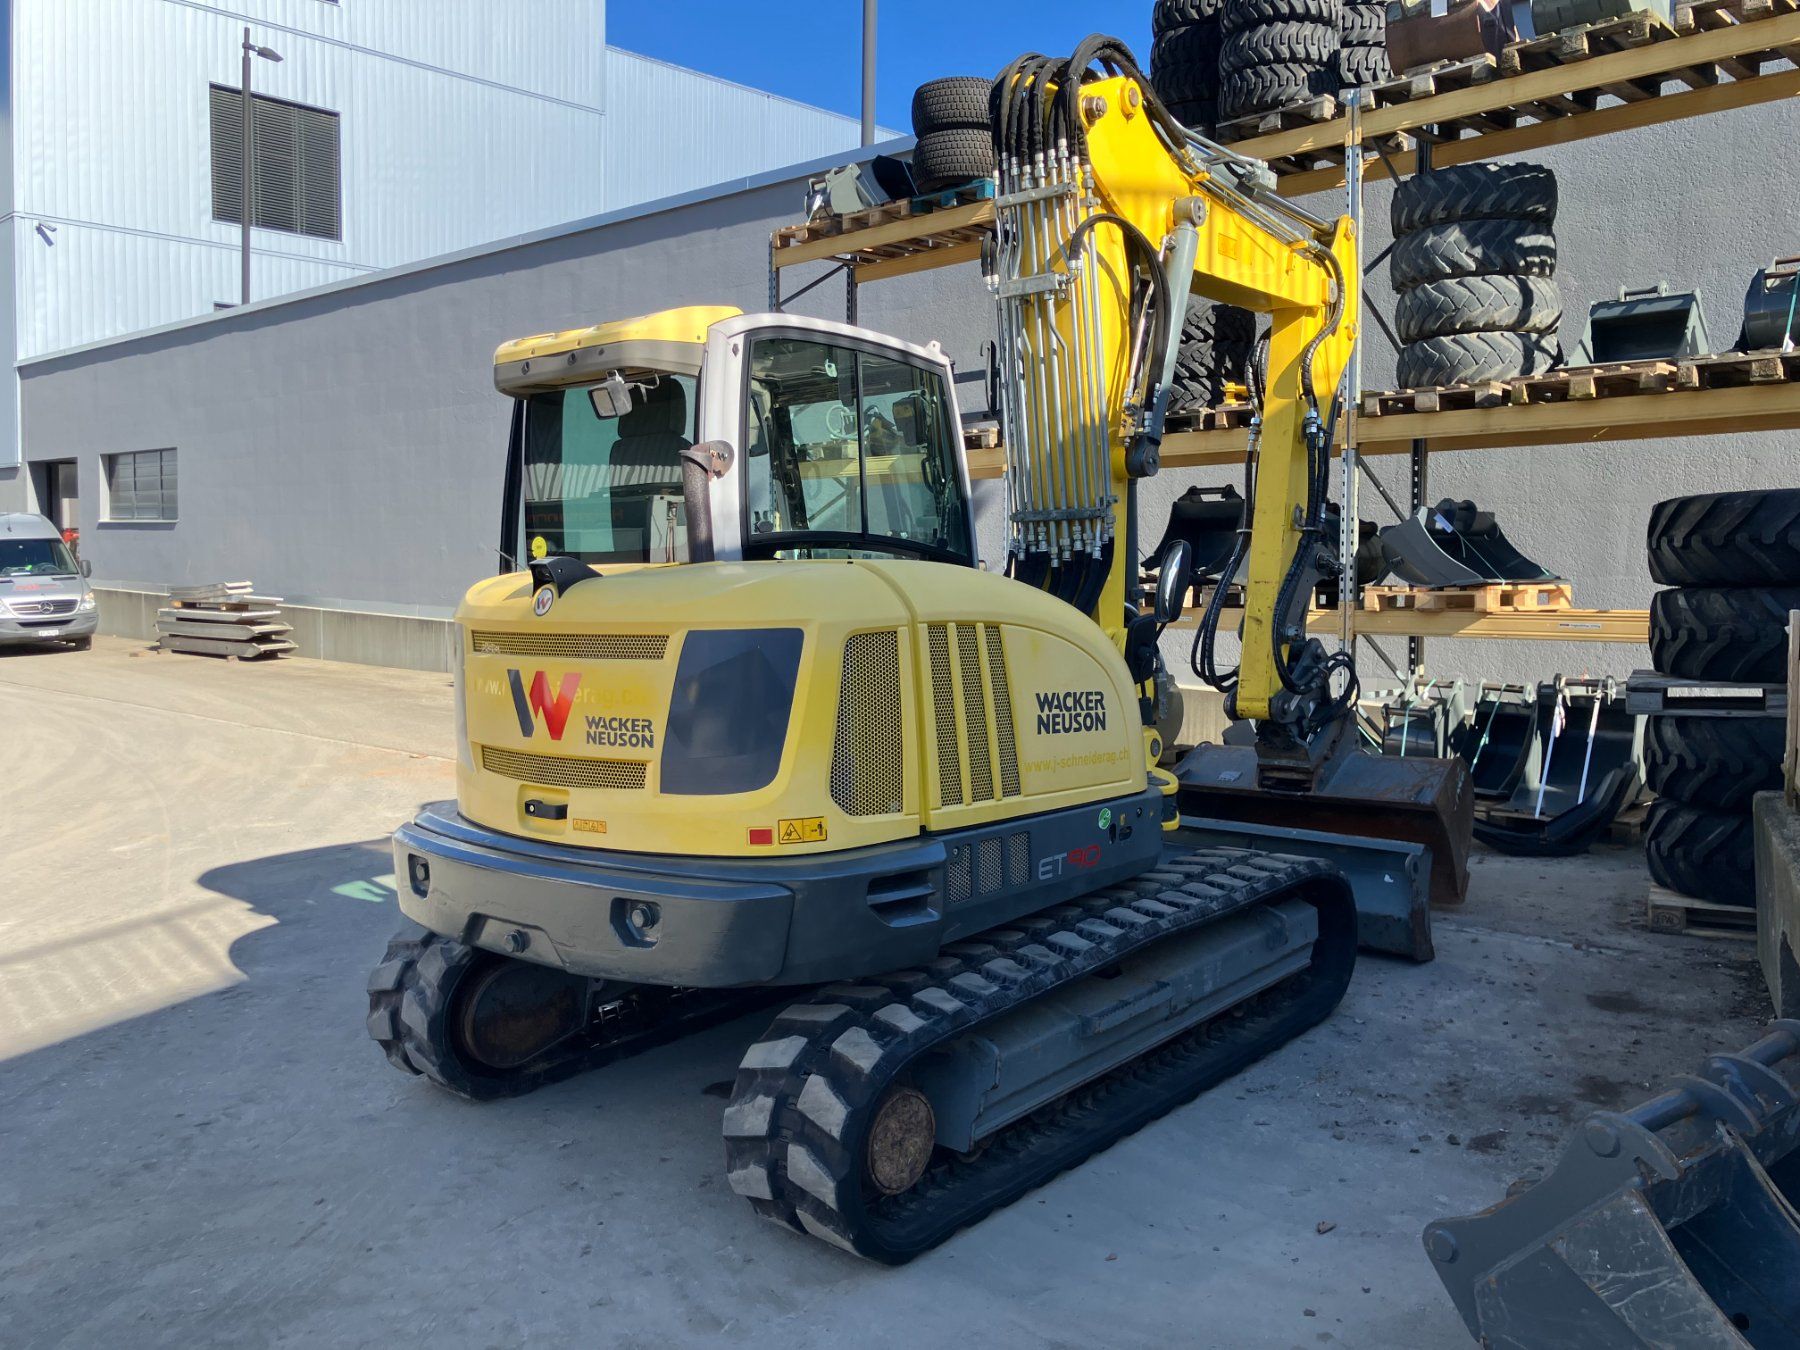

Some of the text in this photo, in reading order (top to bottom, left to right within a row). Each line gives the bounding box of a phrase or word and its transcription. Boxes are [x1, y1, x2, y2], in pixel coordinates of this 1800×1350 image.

[1035, 691, 1105, 713] WACKER
[585, 715, 654, 734] WACKER
[1037, 711, 1106, 735] NEUSON
[586, 731, 655, 749] NEUSON
[1024, 746, 1130, 773] www.j-schneiderag.ch
